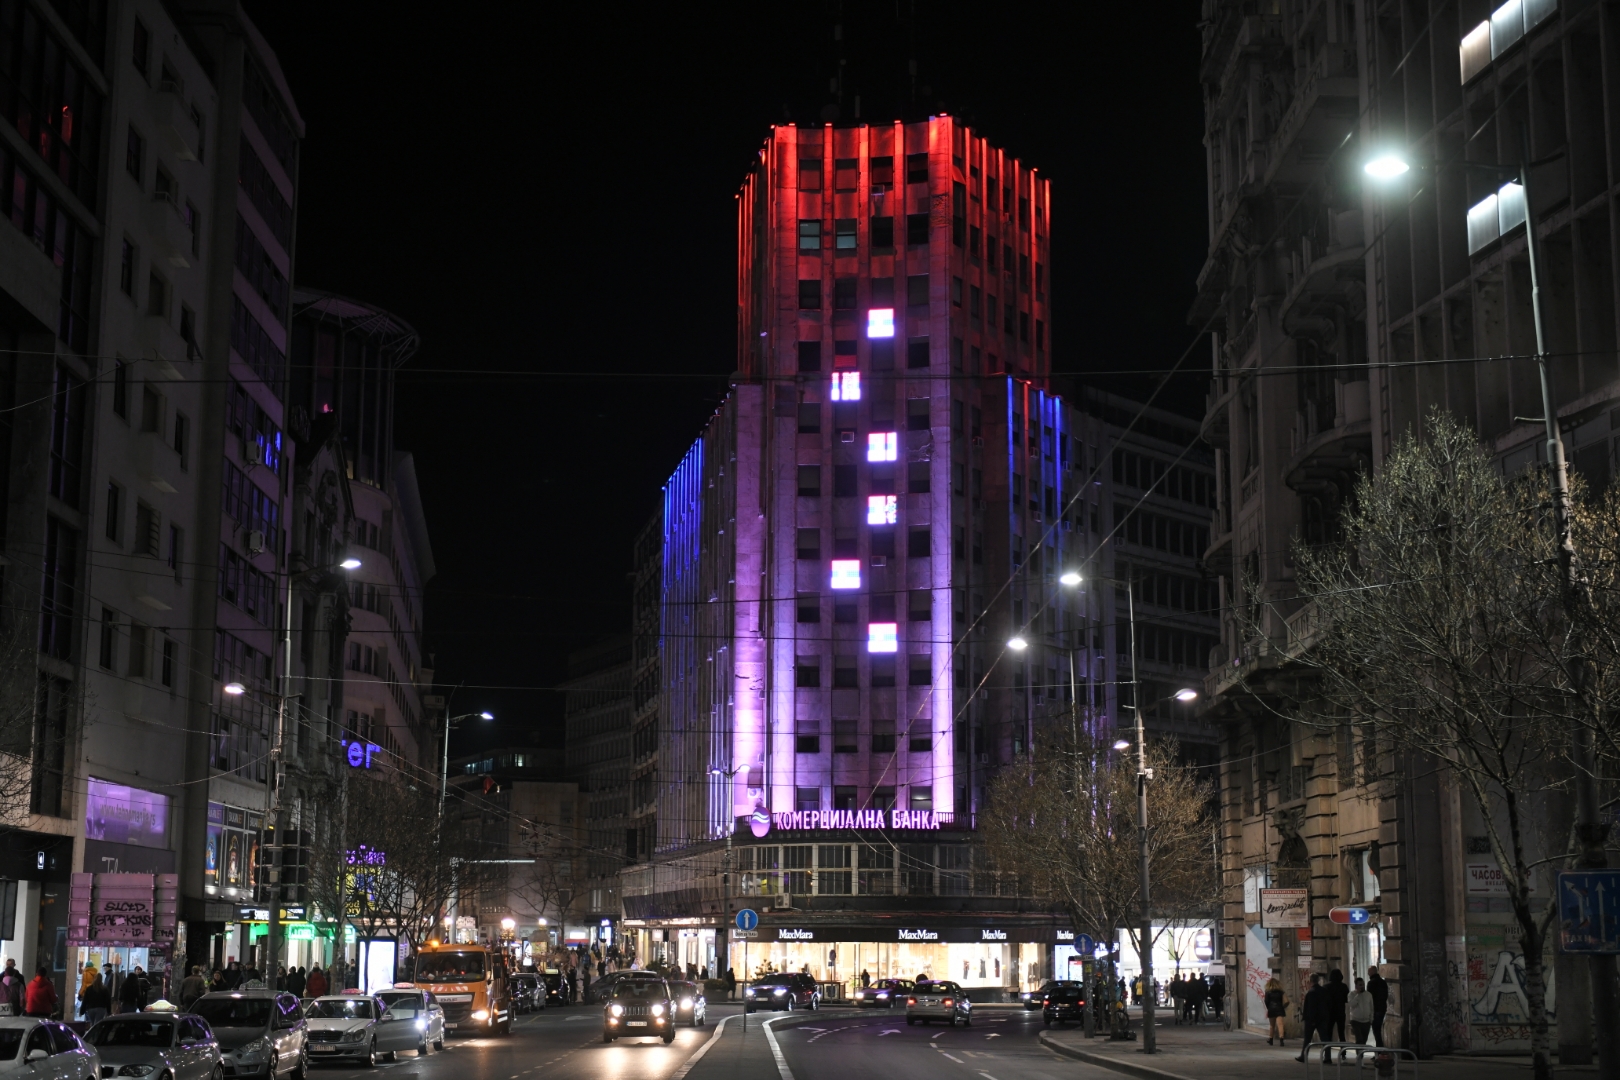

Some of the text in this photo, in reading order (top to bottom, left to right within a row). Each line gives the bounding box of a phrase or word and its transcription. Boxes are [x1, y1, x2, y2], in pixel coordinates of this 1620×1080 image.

[776, 809, 941, 830] КОМЕРЦИЈАЛНА БАНКА
[778, 929, 814, 939] MaxMara
[898, 929, 938, 940] MaxMara
[982, 929, 1007, 940] MaxMara
